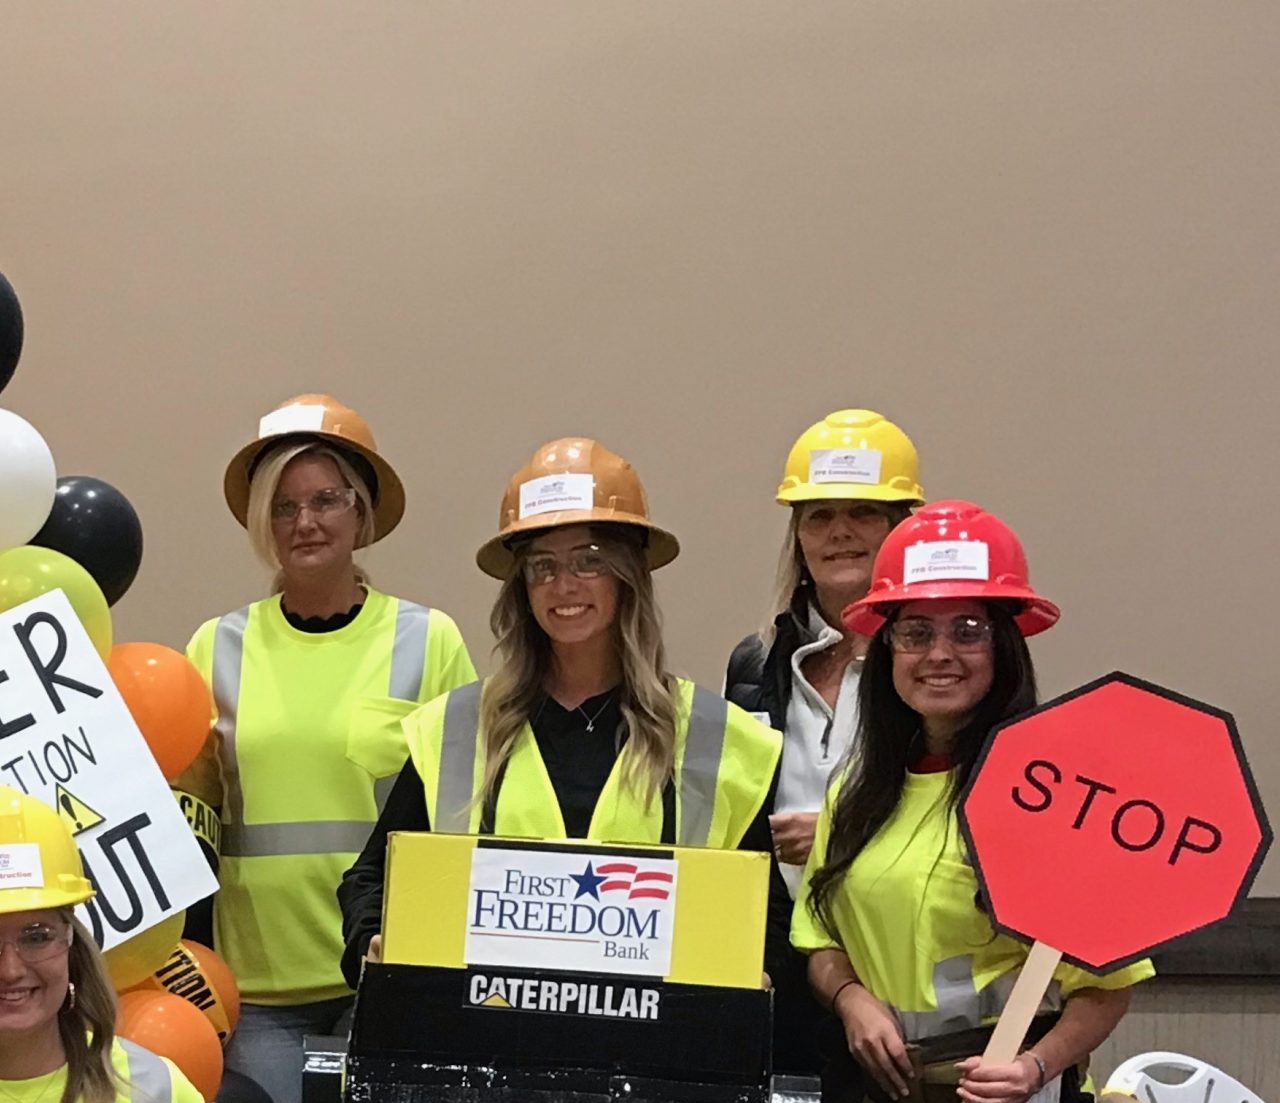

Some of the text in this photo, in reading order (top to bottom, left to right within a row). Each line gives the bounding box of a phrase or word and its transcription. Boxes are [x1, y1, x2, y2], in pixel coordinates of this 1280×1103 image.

[1011, 759, 1222, 866] STOP
[503, 868, 570, 898] FIRST
[470, 889, 661, 940] FREEDOM
[603, 940, 650, 960] Bank
[469, 973, 660, 1020] CATERPILLAR
